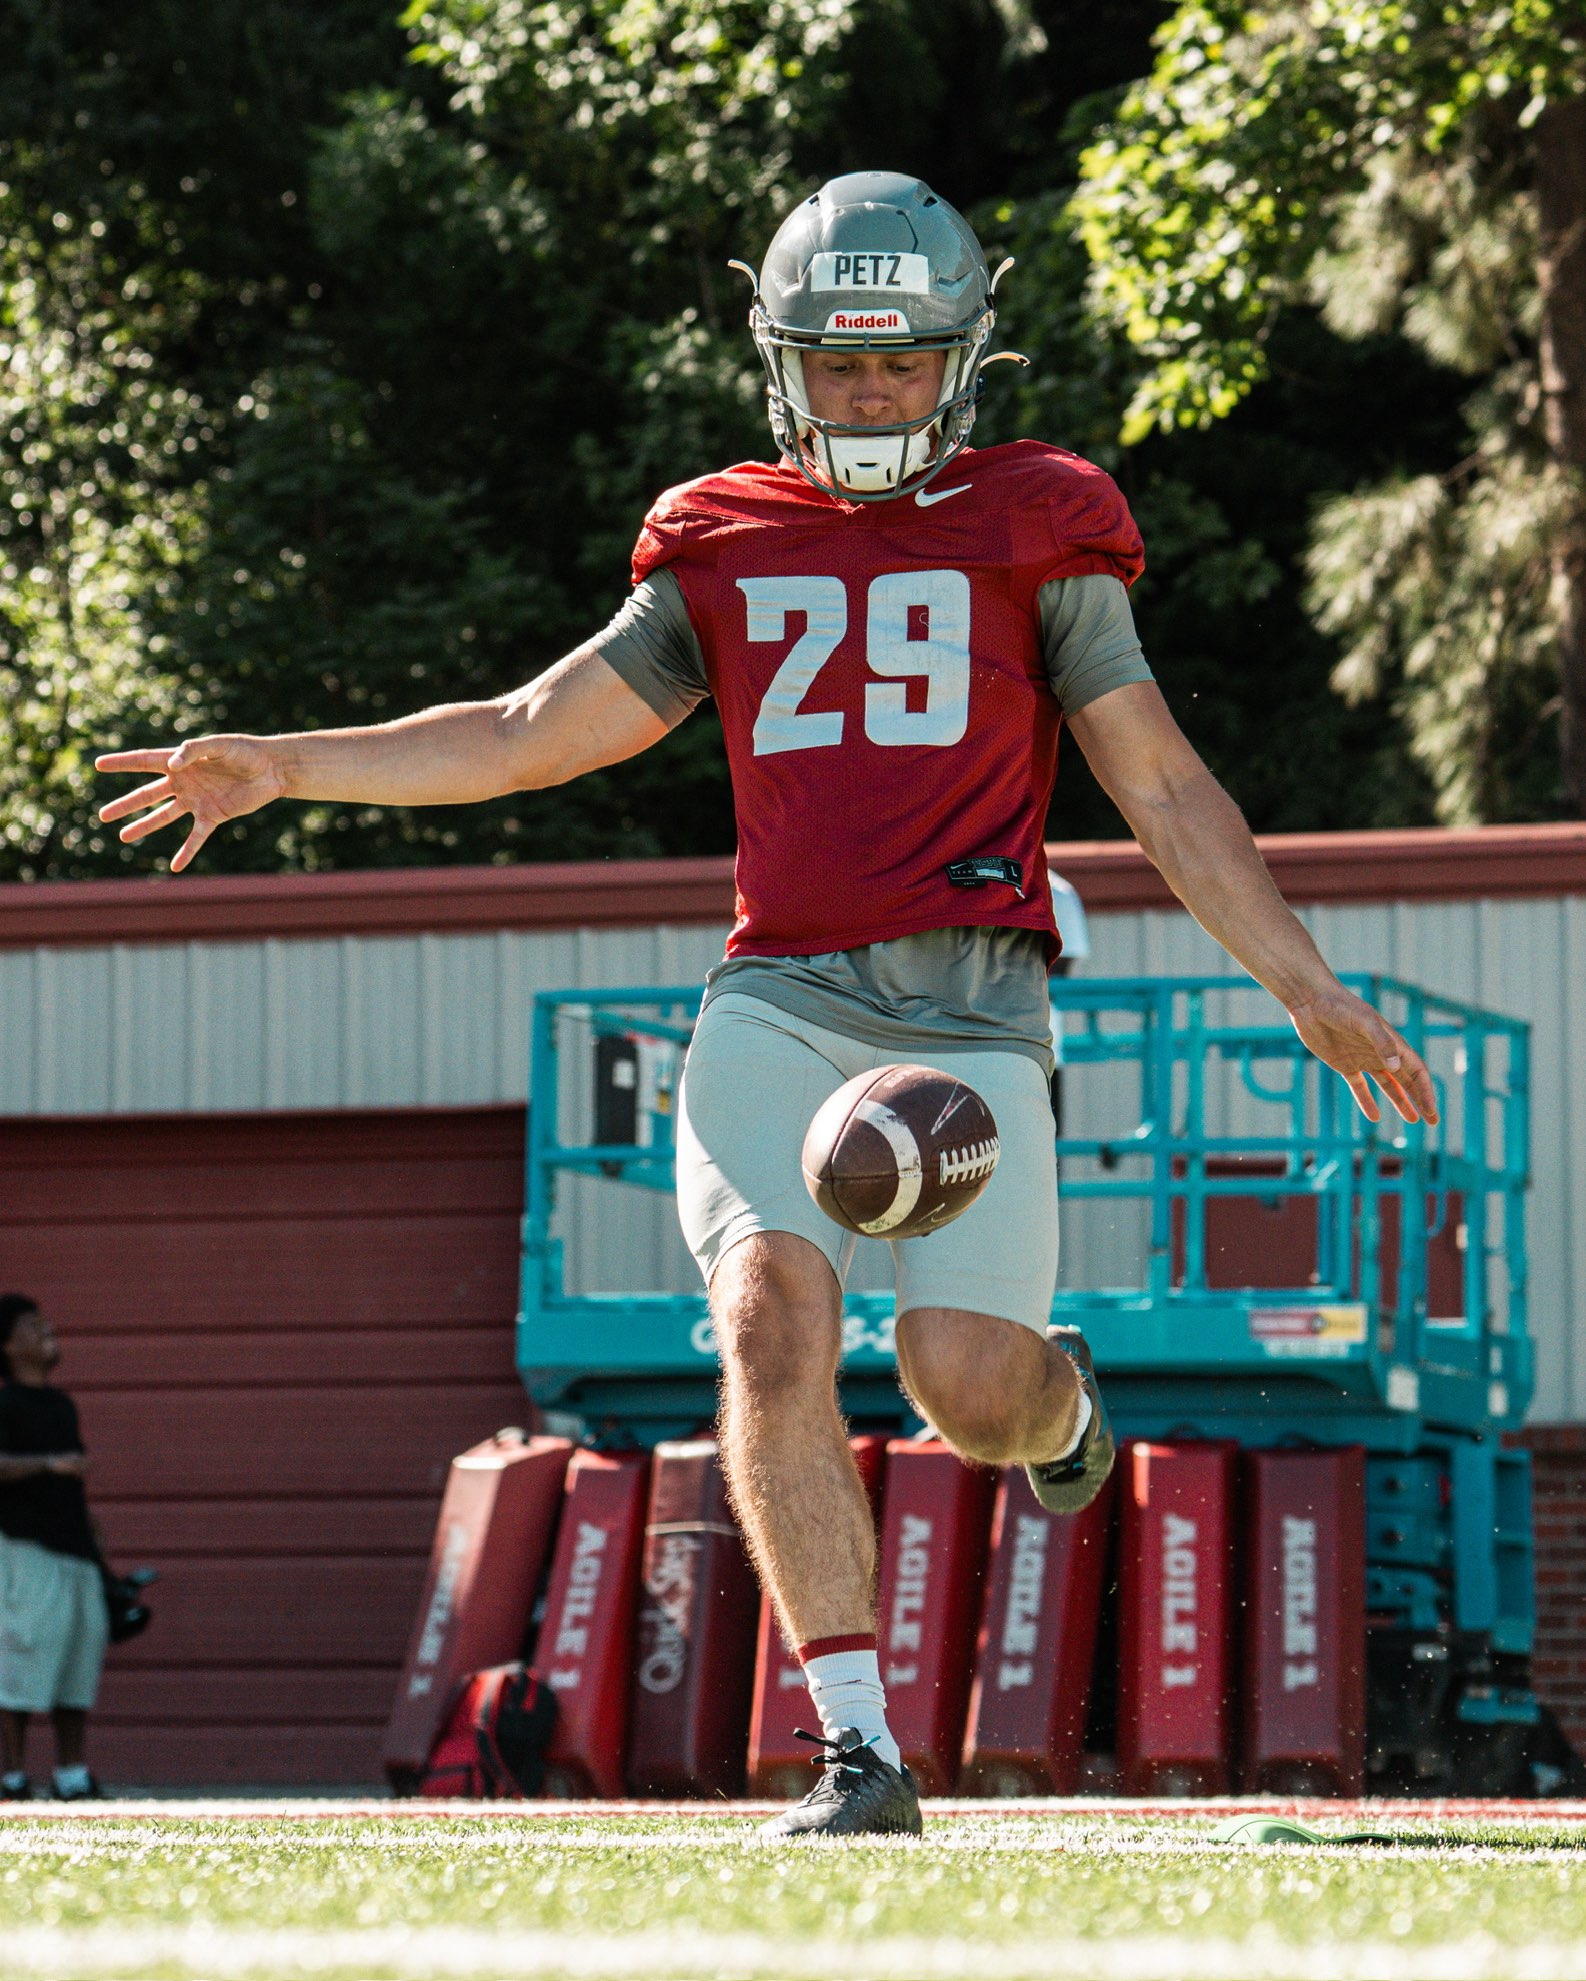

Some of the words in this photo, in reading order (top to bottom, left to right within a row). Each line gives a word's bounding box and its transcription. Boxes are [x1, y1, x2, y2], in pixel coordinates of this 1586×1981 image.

[834, 255, 902, 286] PETZ
[834, 314, 898, 329] Riddell
[735, 569, 971, 756] 29
[1162, 1512, 1196, 1652] AGILE
